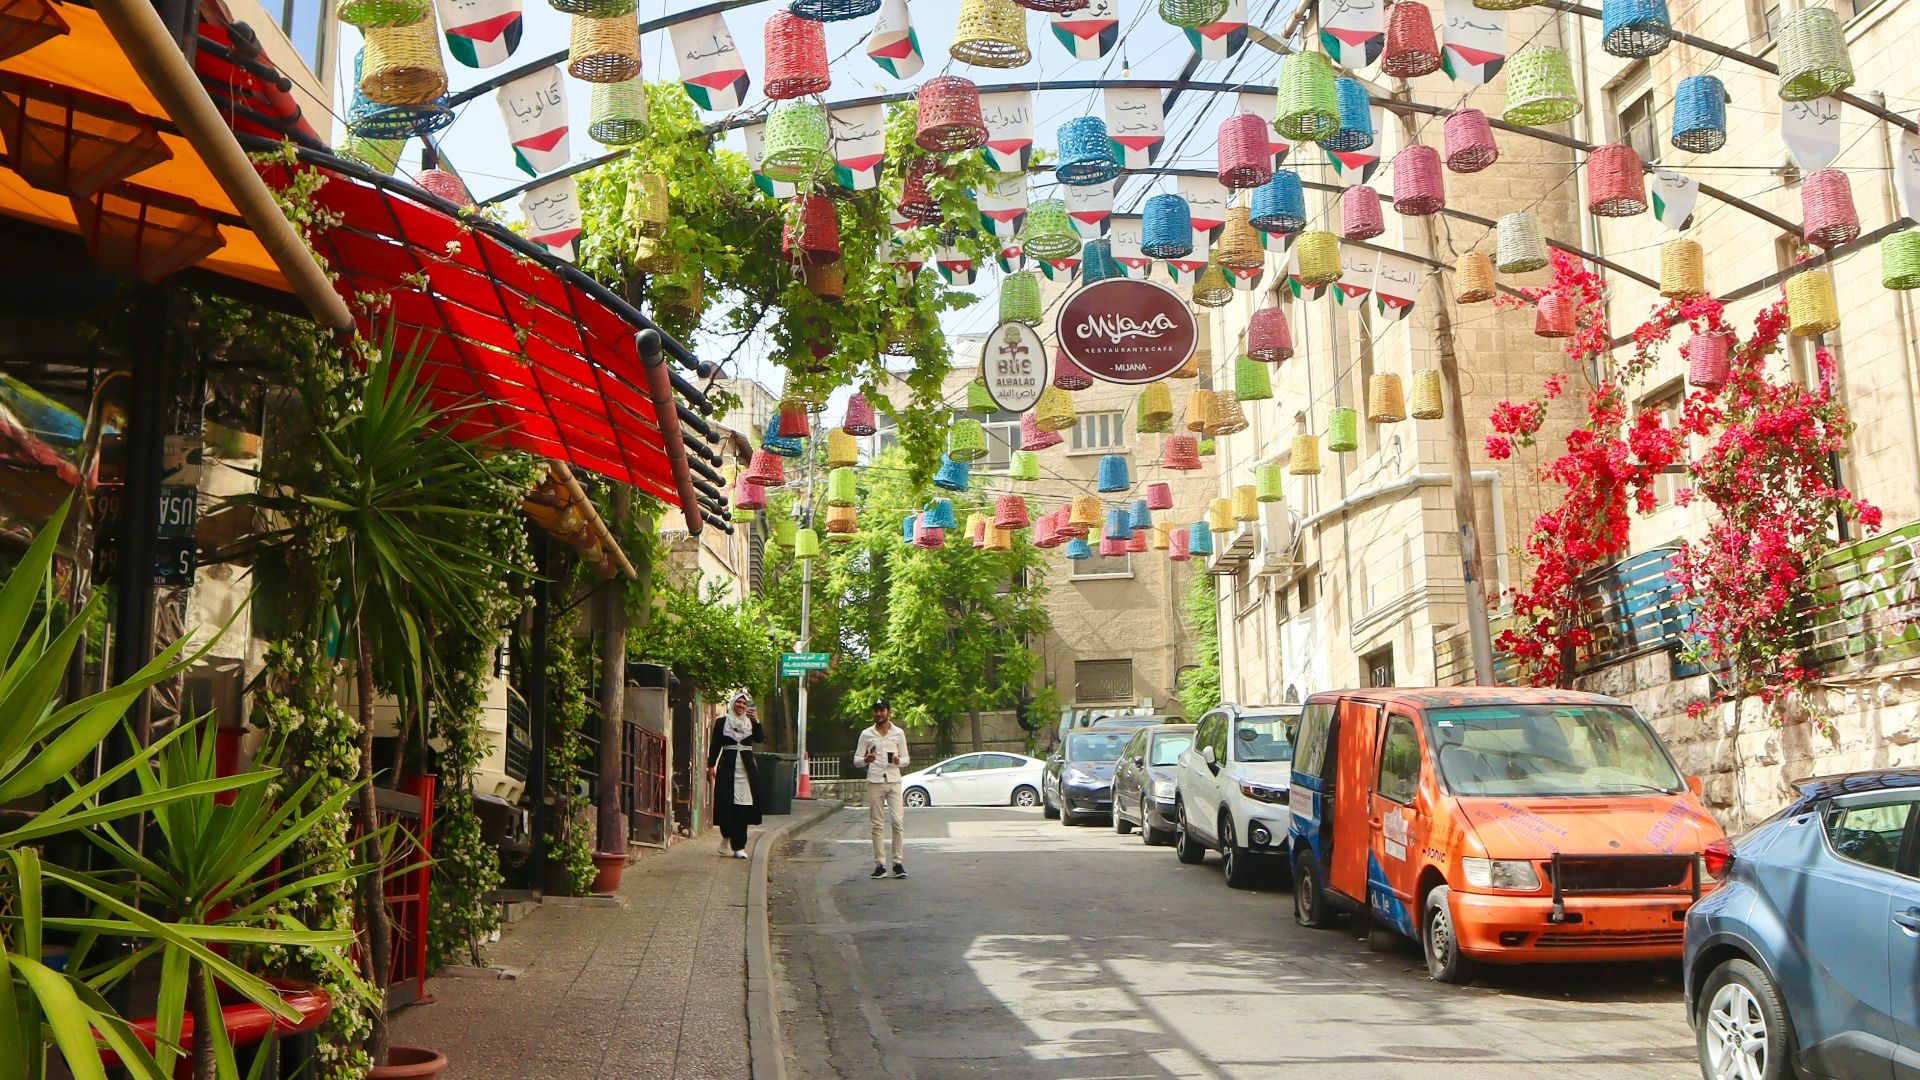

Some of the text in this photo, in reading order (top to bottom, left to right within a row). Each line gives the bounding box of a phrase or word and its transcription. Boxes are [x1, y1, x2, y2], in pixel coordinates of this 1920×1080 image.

[1115, 101, 1147, 115] بيت
[1115, 364, 1147, 372] MIJANA
[997, 378, 1036, 387] ALBALAD
